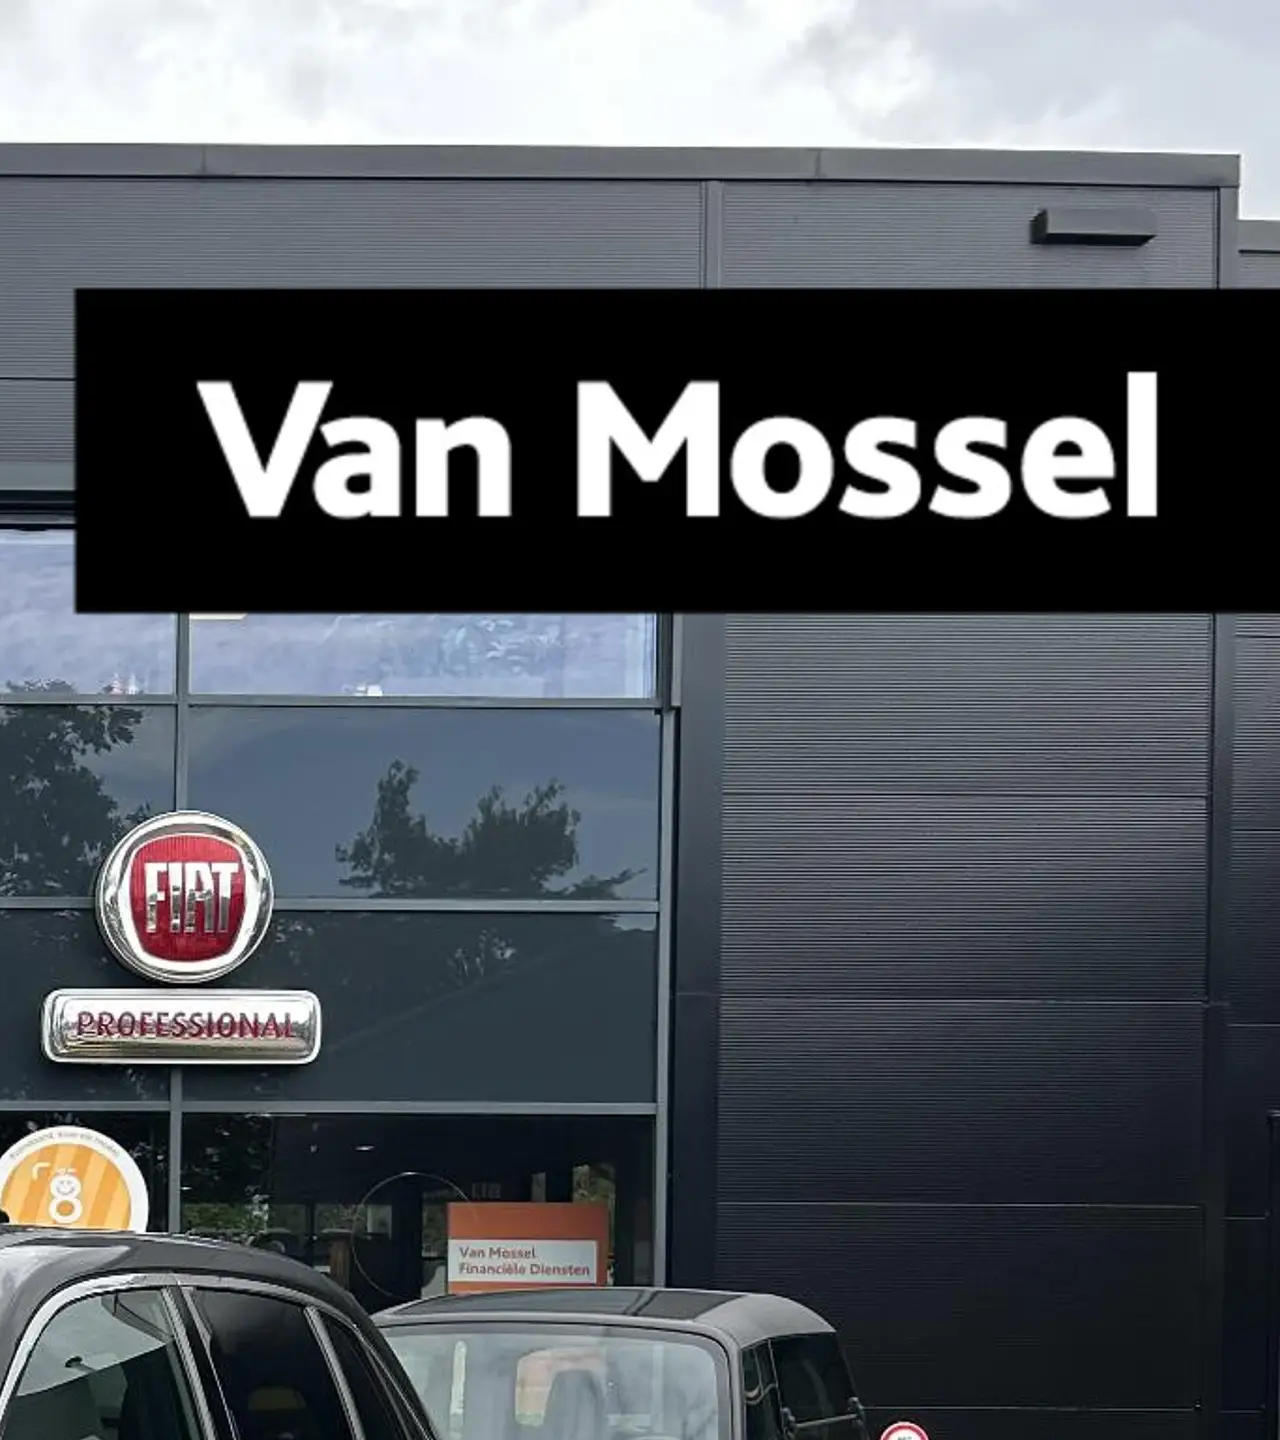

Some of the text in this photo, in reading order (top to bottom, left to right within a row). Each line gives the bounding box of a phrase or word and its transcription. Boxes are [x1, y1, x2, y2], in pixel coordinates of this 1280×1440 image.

[144, 861, 239, 934] FIAT
[76, 1010, 298, 1039] PROFESSIONAL
[459, 1246, 537, 1260] Van Mossel
[530, 1263, 590, 1276] Diensten
